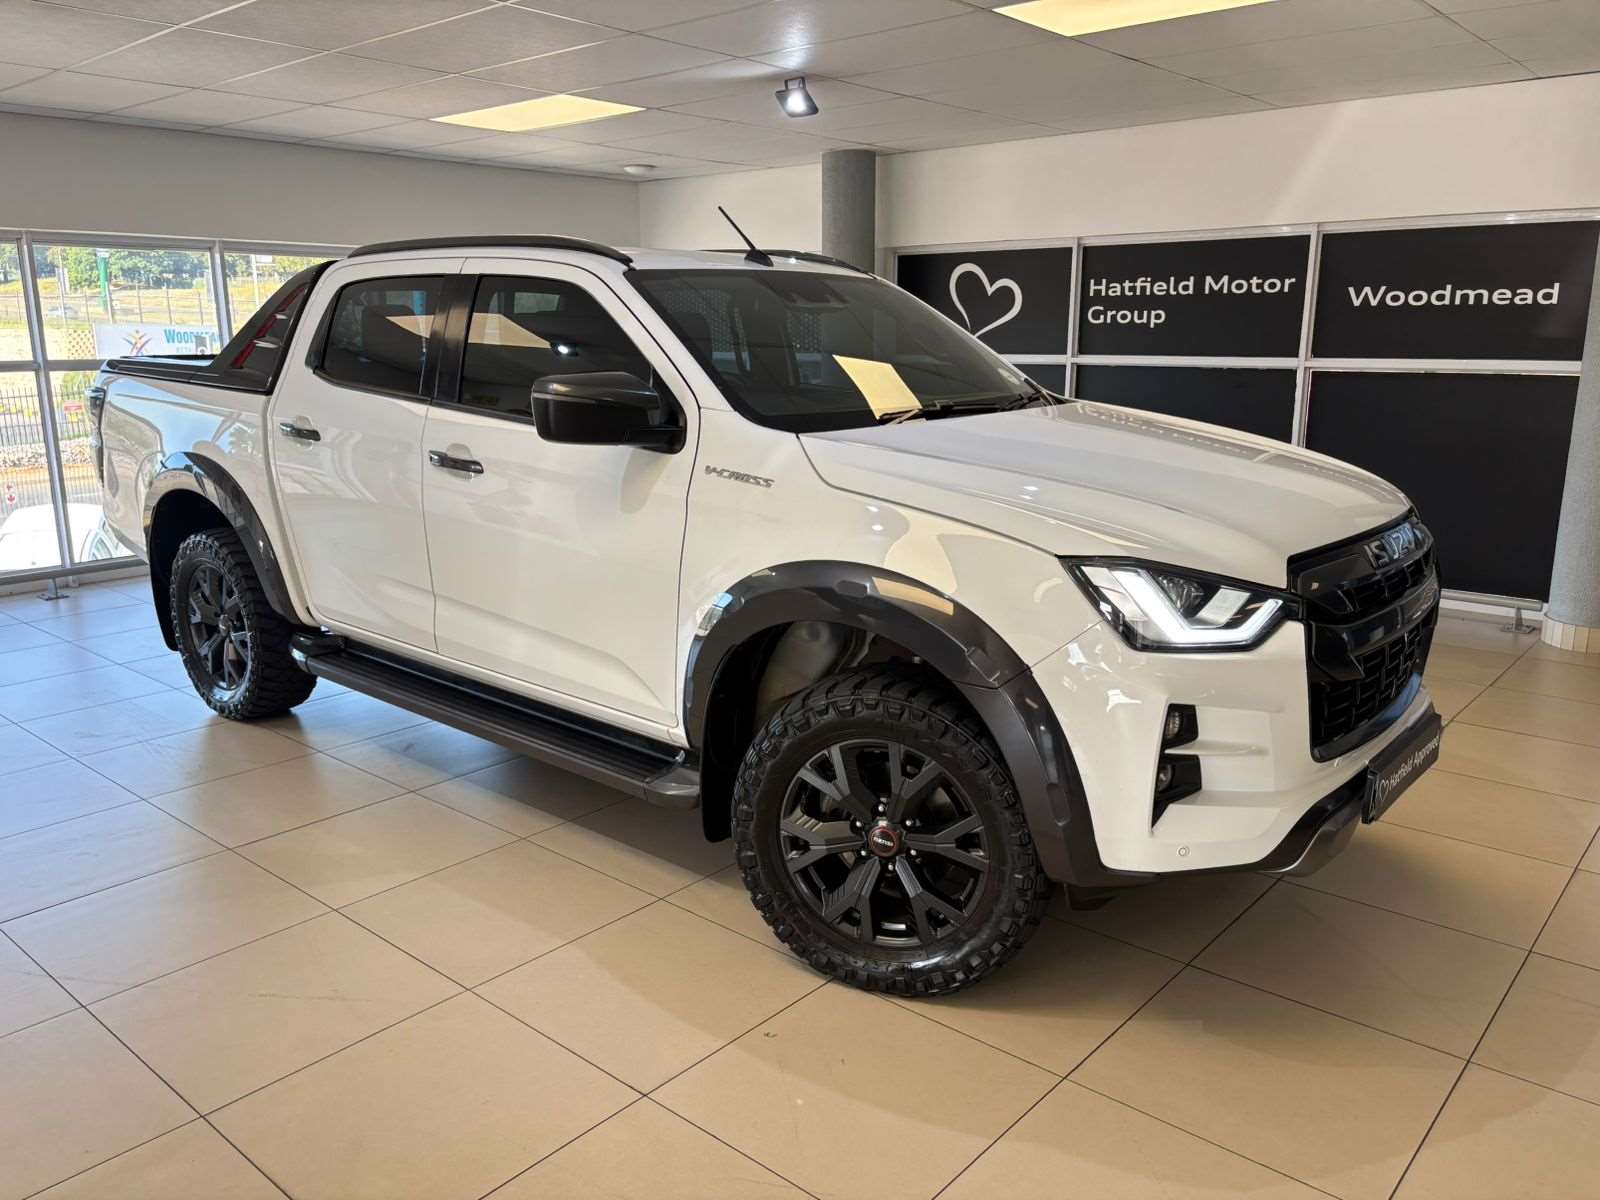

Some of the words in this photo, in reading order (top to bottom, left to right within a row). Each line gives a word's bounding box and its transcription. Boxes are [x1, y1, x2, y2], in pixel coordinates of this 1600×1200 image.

[1089, 276, 1194, 297] Hatfield
[1204, 274, 1296, 294] Motor
[1348, 282, 1561, 307] Woodmead
[1087, 305, 1166, 328] Group
[1363, 526, 1424, 569] ISUZU
